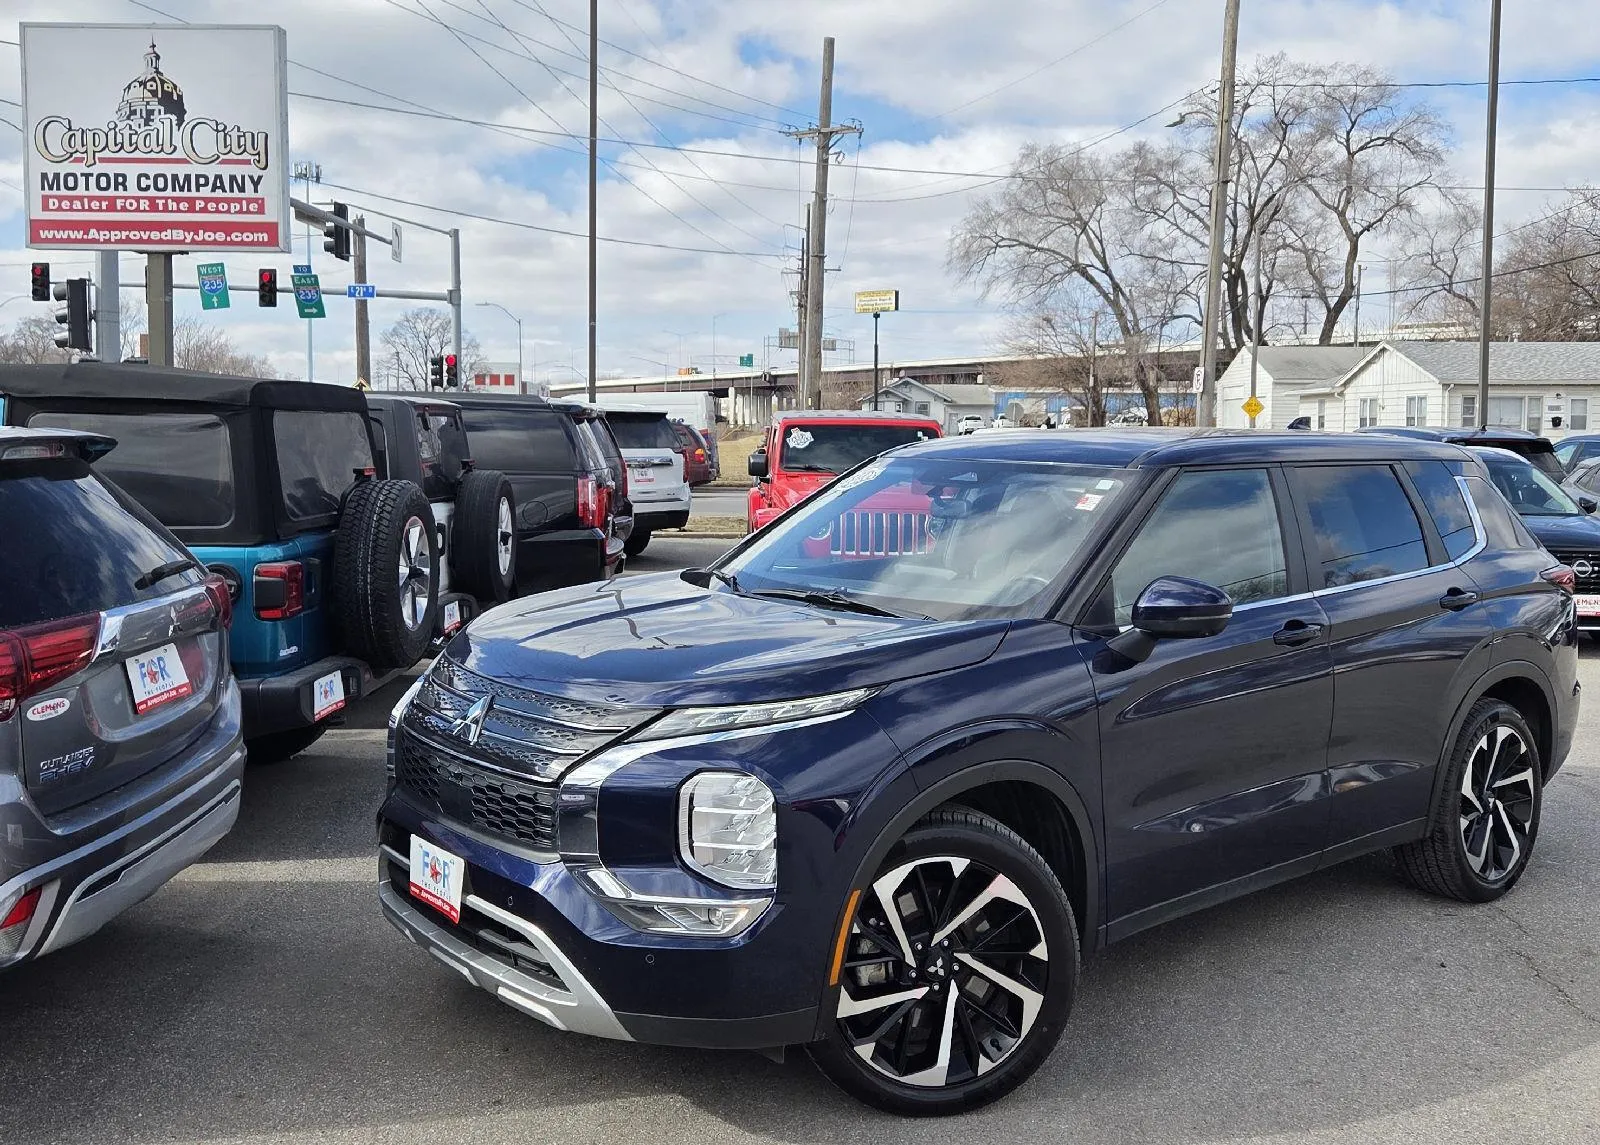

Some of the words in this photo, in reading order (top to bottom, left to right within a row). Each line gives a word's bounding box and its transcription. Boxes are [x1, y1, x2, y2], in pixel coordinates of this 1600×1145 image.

[34, 115, 177, 168] Capital
[181, 118, 269, 170] City
[40, 172, 128, 192] MOTOR
[136, 174, 264, 194] COMPANY
[48, 198, 109, 211] Dealer
[116, 199, 150, 211] FOR
[156, 199, 188, 211] The
[195, 200, 259, 214] People
[39, 228, 269, 243] www.ApprovedByJoe.com
[200, 266, 222, 275] WEST
[204, 280, 223, 290] 235
[294, 276, 316, 285] EAST
[299, 289, 318, 300] 235
[31, 700, 66, 715] CLEMENS
[422, 849, 450, 889] FOR
